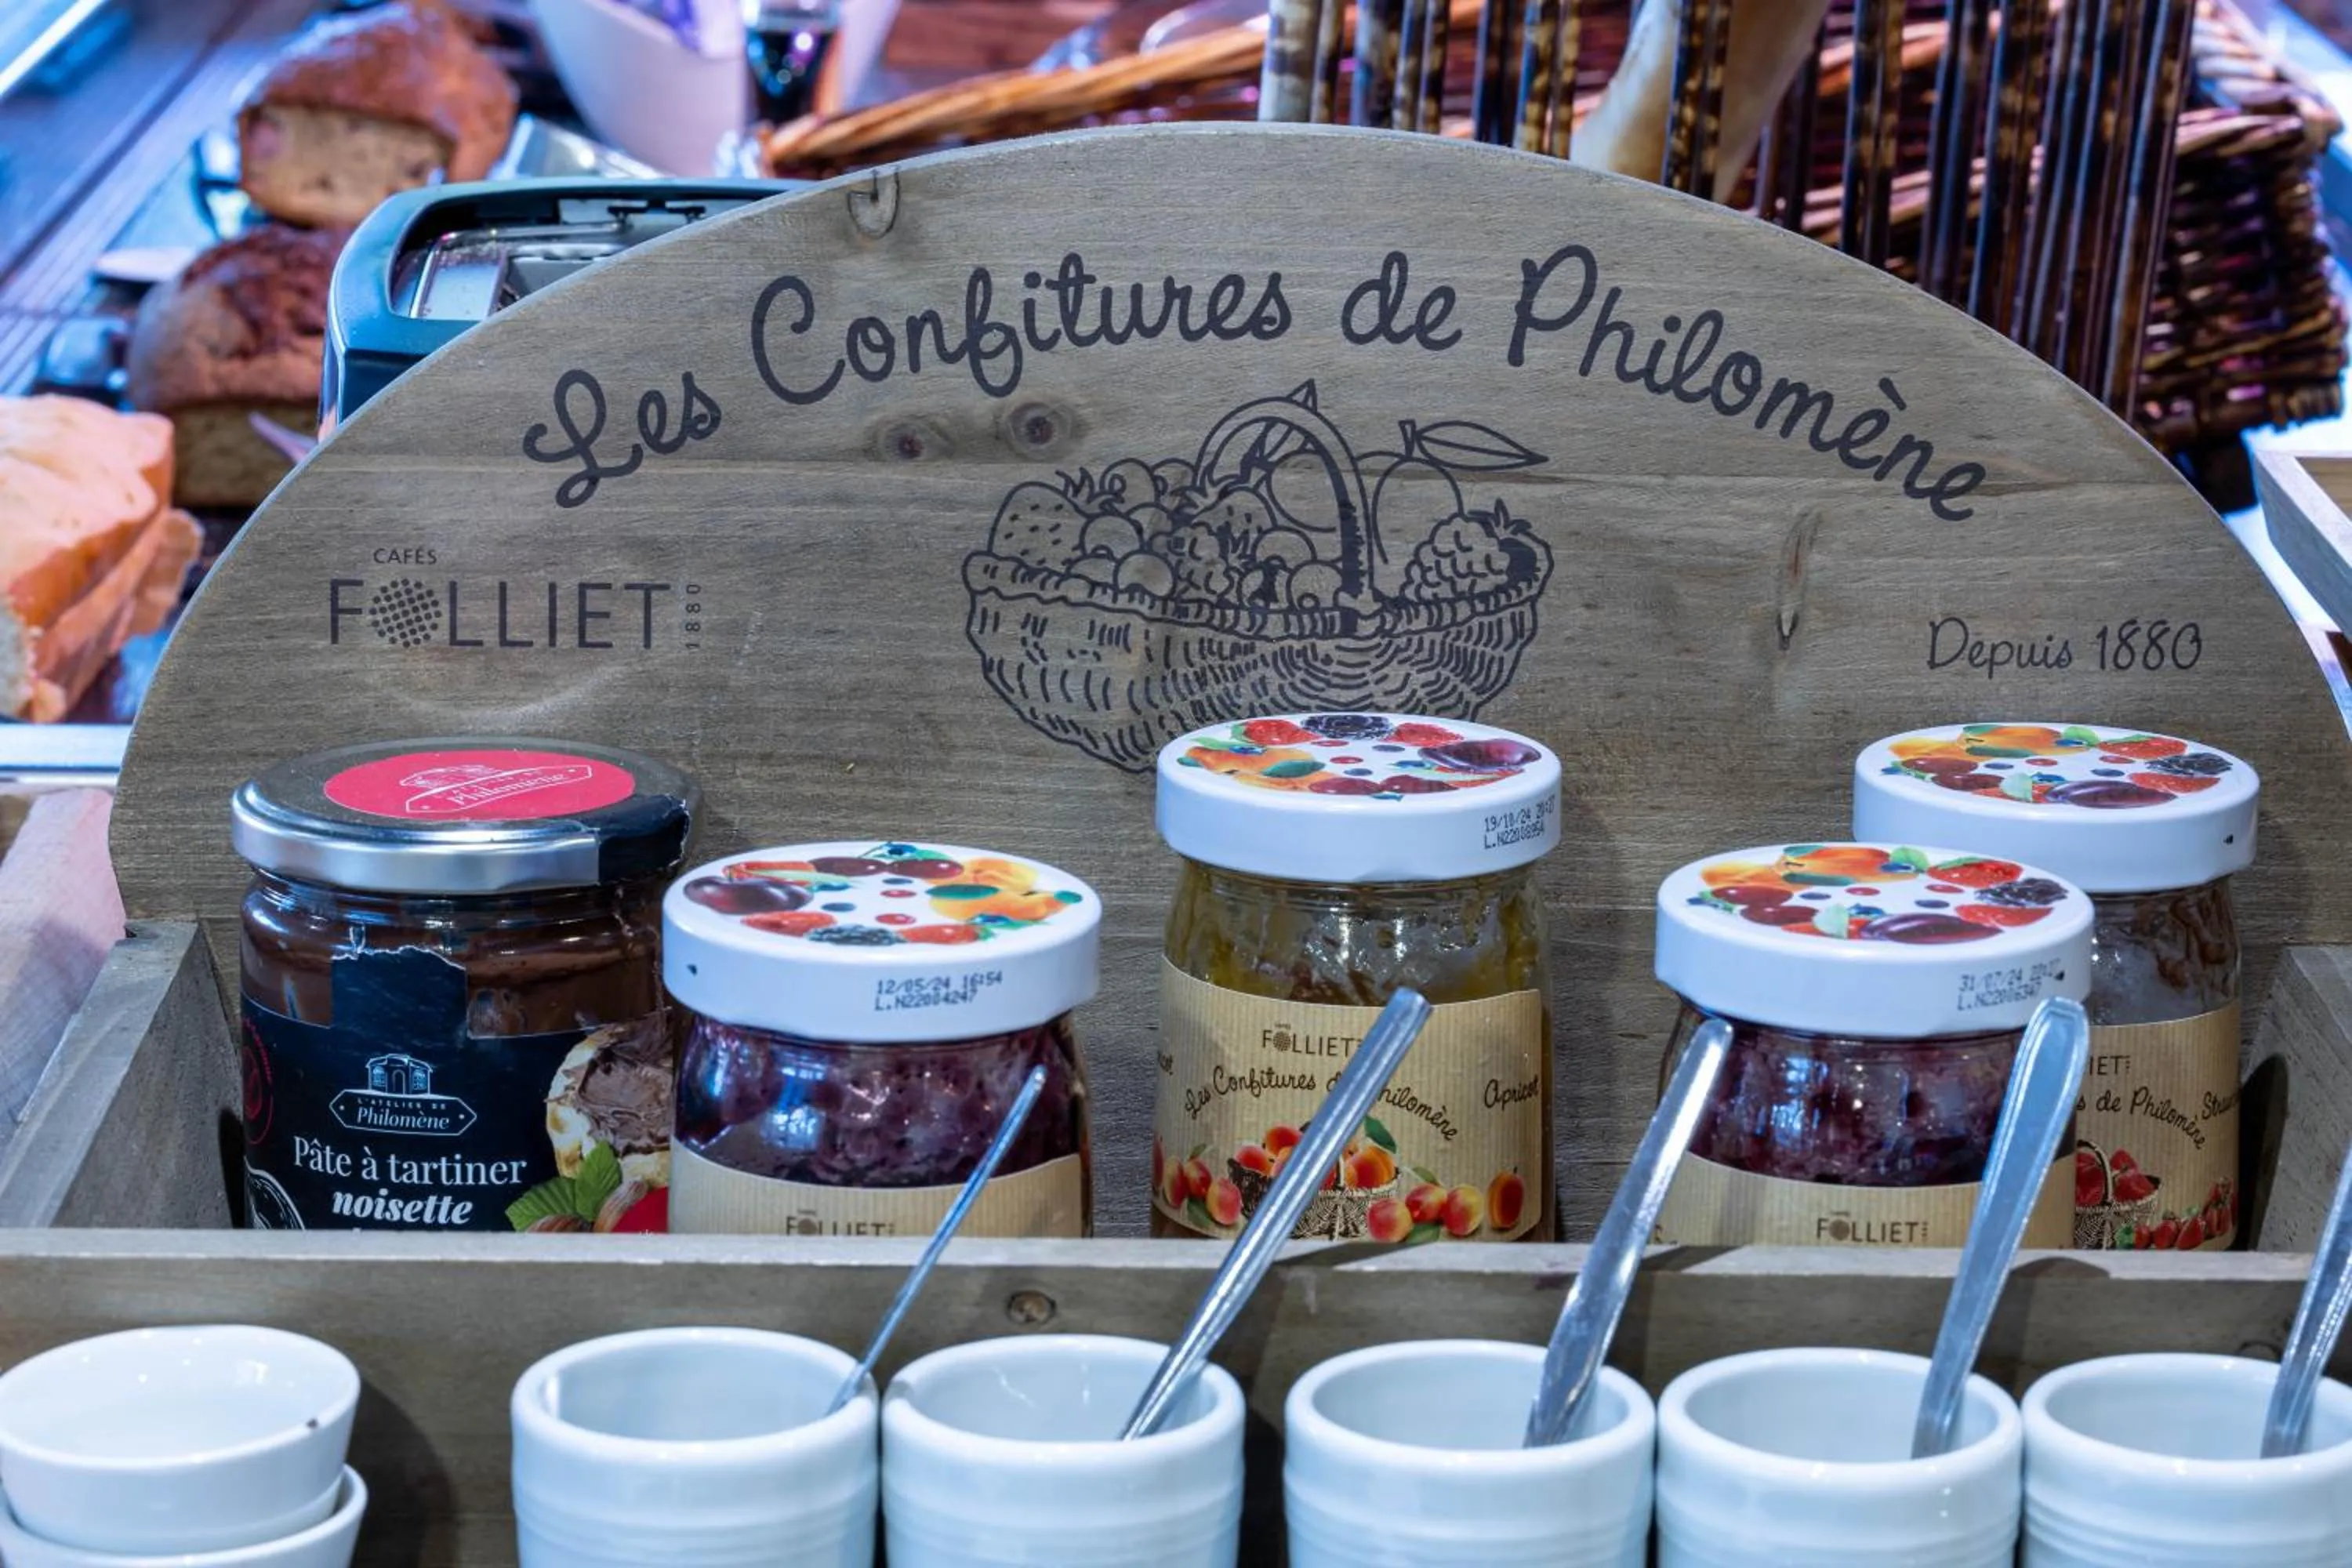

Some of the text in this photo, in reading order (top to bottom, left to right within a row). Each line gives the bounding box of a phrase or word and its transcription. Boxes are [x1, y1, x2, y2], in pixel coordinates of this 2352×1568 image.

[523, 244, 1987, 521] Les Confitures de Philomène
[684, 583, 702, 650] 1880
[1926, 616, 2202, 680] Depuis 1880
[877, 976, 951, 995] 12/05/24
[357, 1106, 450, 1130] Philomène
[1185, 1087, 1211, 1120] Les
[1213, 1065, 1316, 1098] Confitures
[1484, 1074, 1539, 1112] Apricot
[2096, 1089, 2122, 1112] de
[2129, 1085, 2206, 1151] Philomène
[293, 1135, 528, 1185] Pâte à tartiner
[332, 1188, 474, 1225] noisette
